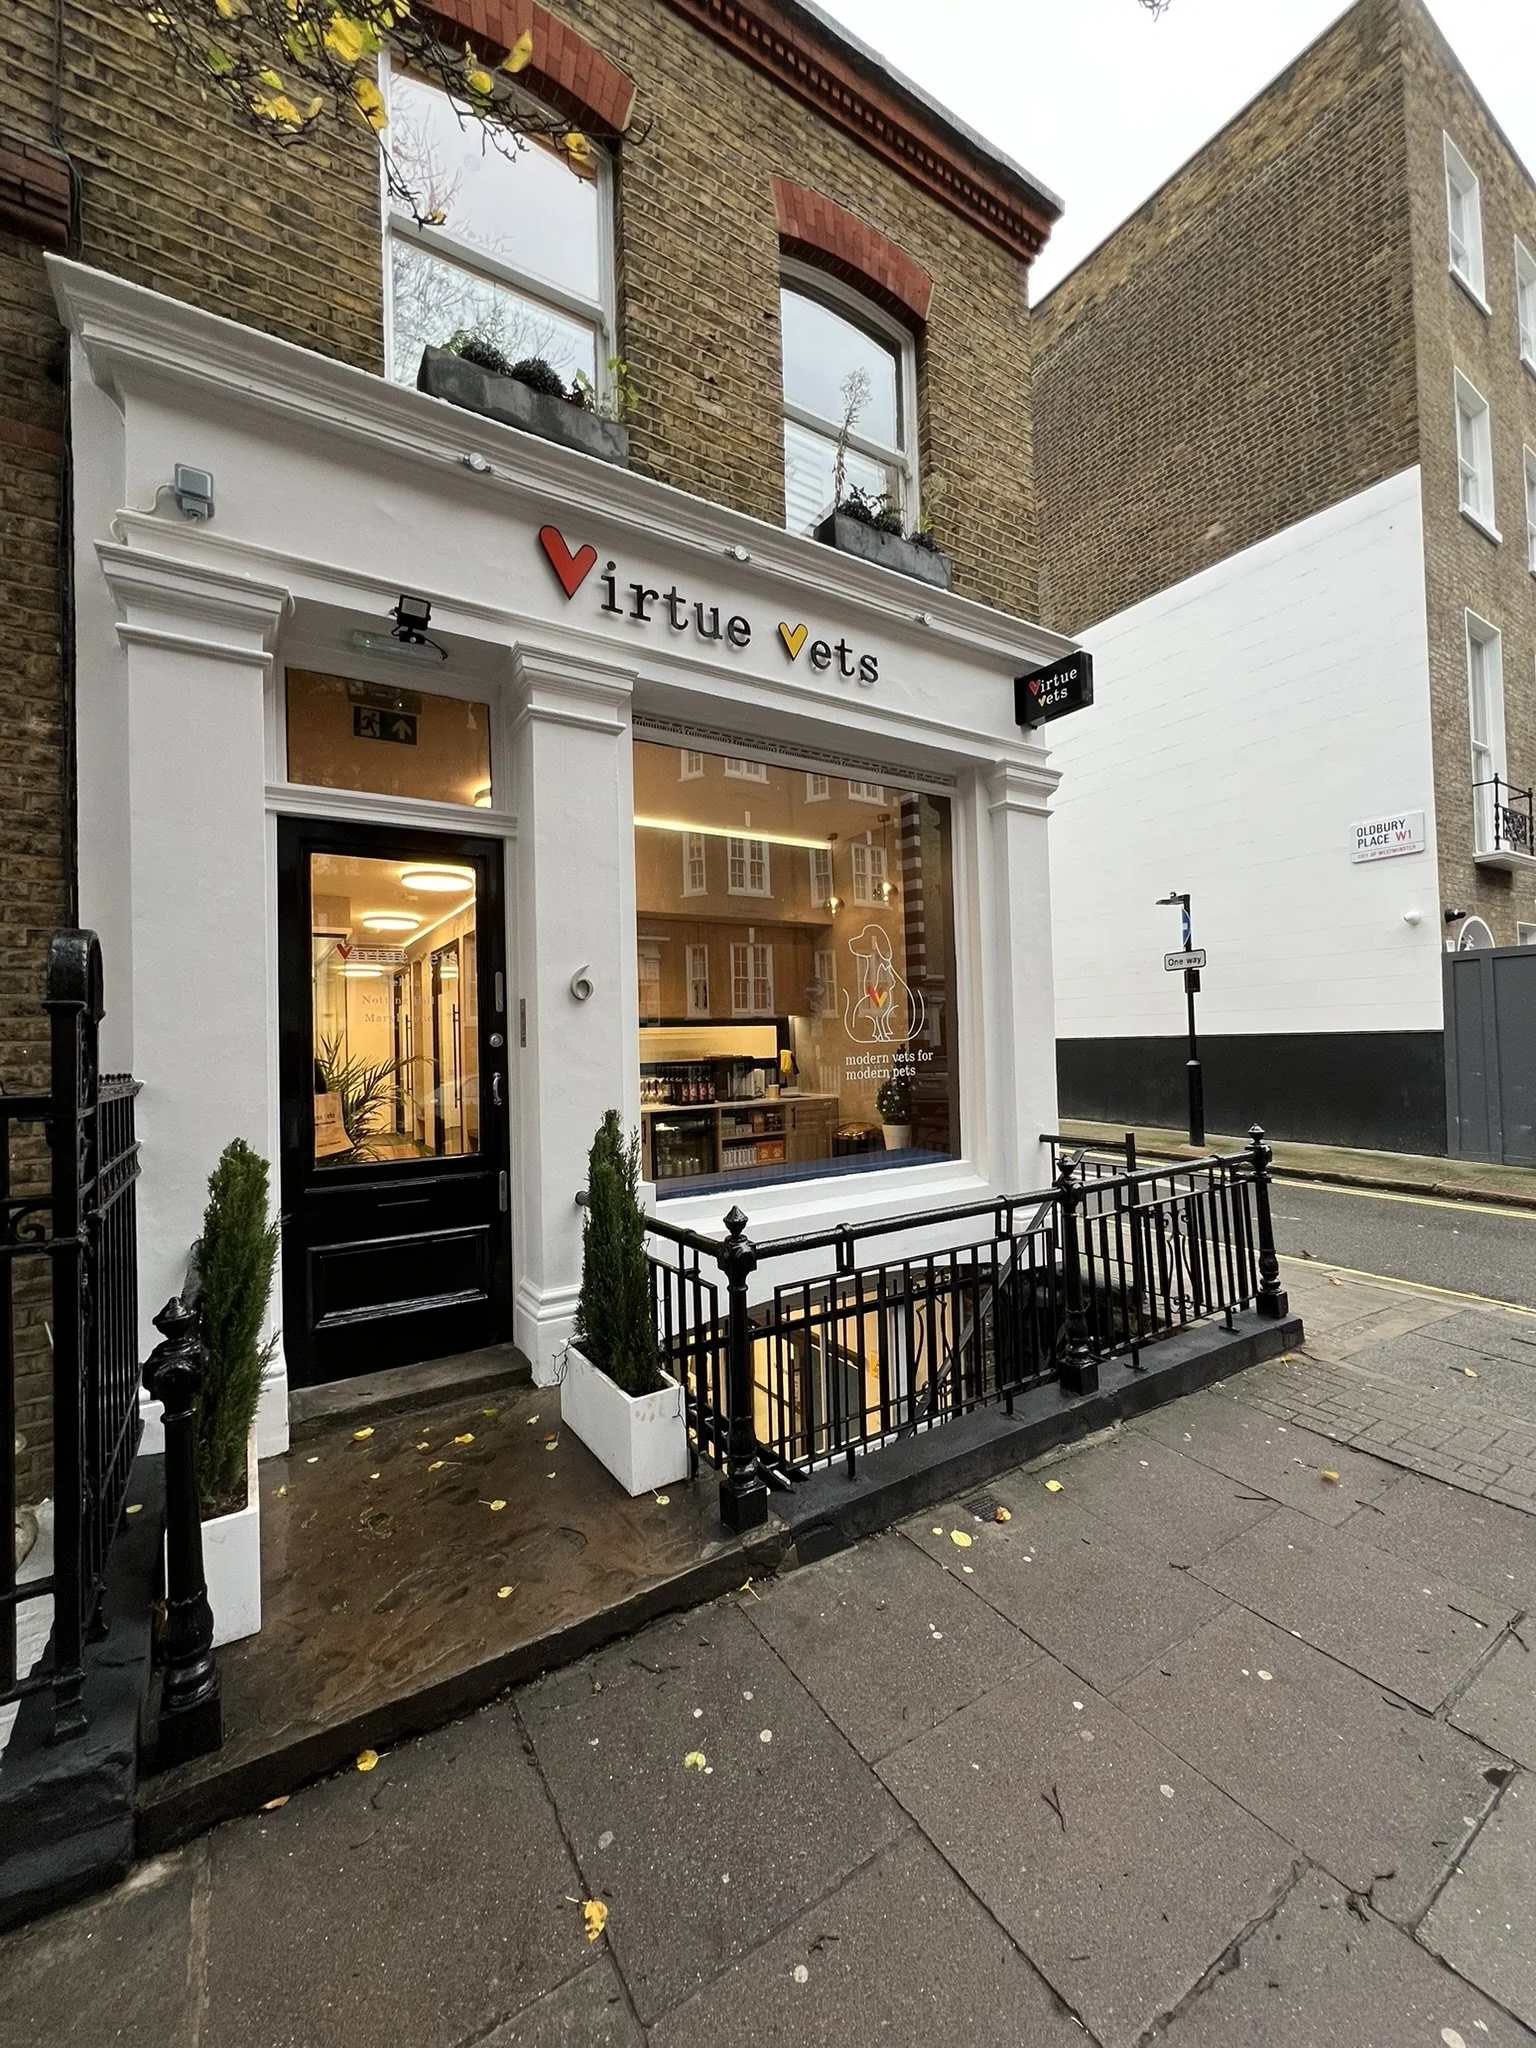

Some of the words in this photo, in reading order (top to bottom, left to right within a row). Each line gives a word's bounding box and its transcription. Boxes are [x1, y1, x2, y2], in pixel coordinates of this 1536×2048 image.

[538, 525, 752, 647] Virtue
[1029, 668, 1077, 696] Virtue
[1356, 819, 1406, 838] OLDBURY
[1357, 833, 1390, 848] PLACE
[1395, 829, 1412, 841] W1
[1168, 958, 1184, 966] One
[1186, 957, 1202, 965] way
[570, 964, 595, 1001] 6
[845, 1051, 889, 1065] modern
[892, 1051, 916, 1062] vets
[917, 1049, 934, 1062] for
[846, 1067, 890, 1080] modern
[892, 1065, 916, 1079] pets
